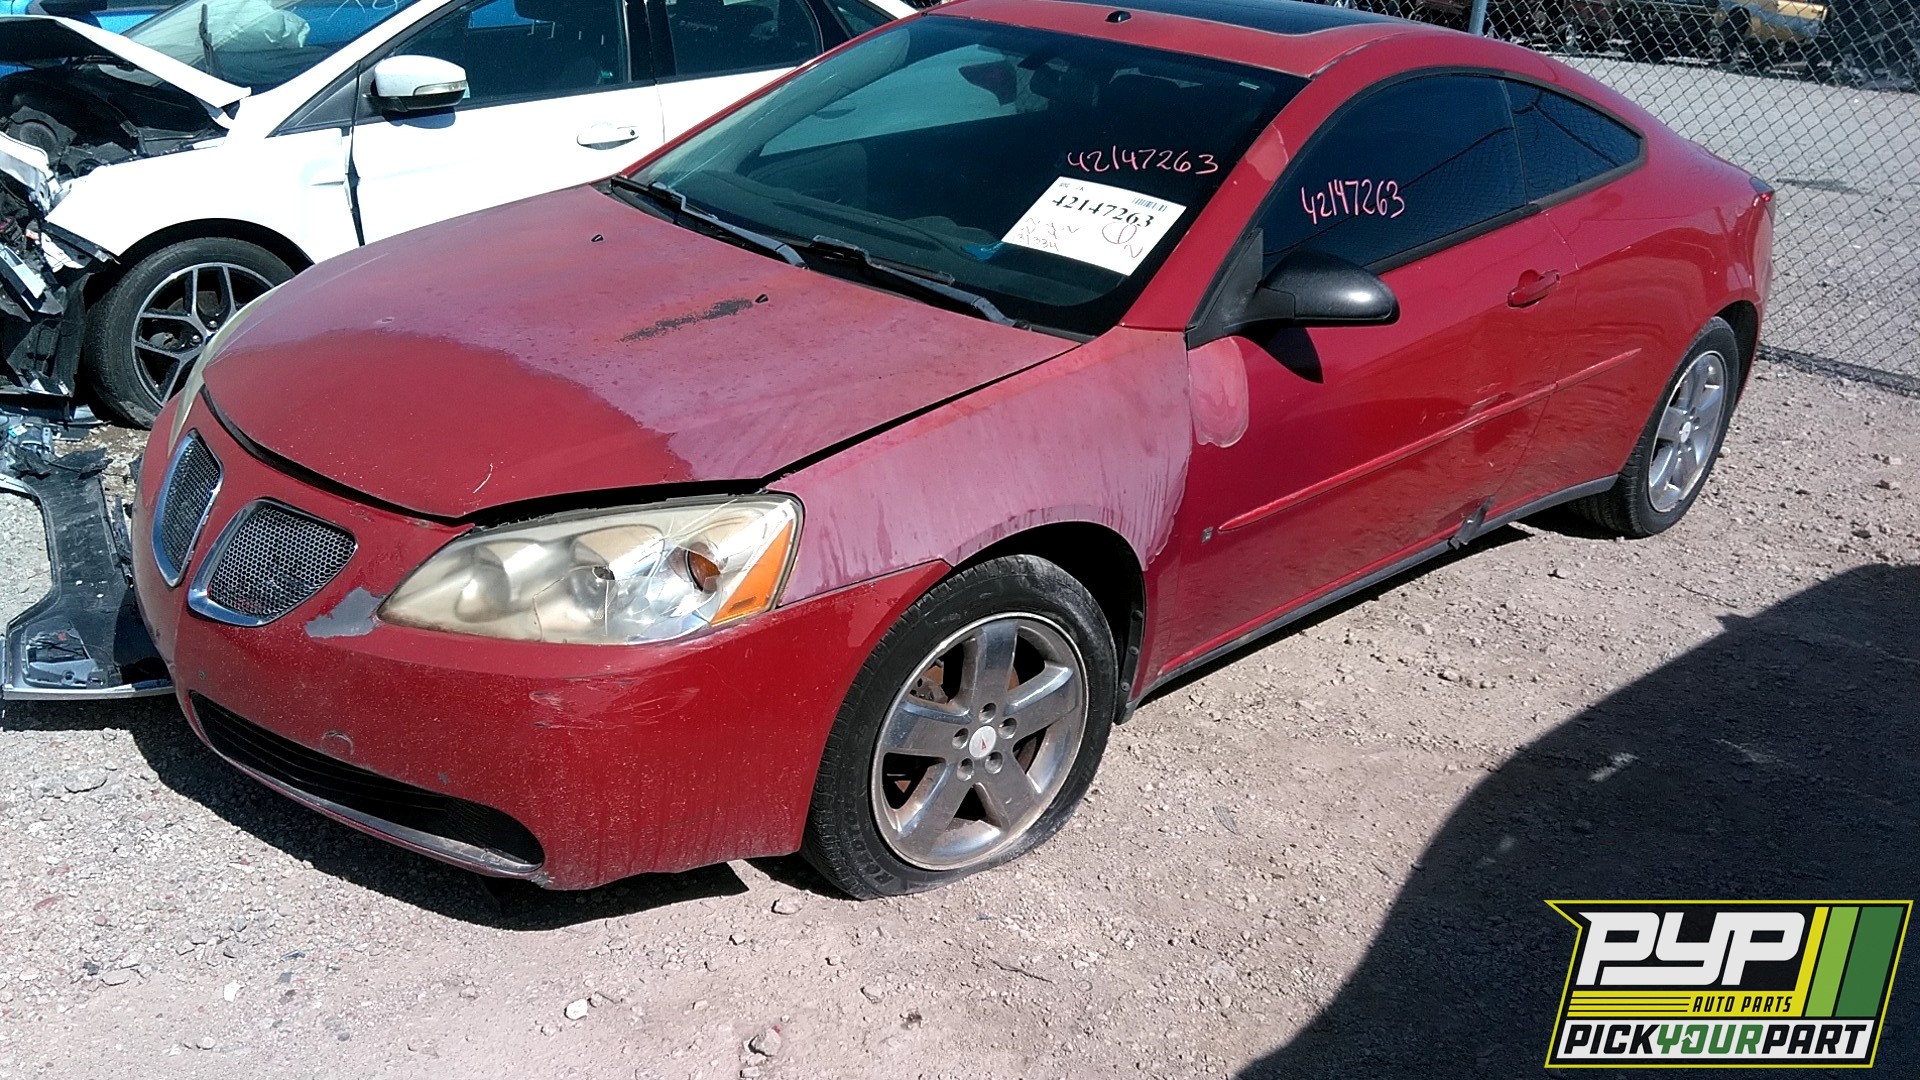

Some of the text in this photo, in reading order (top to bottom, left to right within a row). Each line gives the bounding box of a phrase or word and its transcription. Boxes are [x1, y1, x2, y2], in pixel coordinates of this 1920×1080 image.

[1067, 145, 1219, 175] 42147263
[1052, 195, 1154, 227] 42147263
[1301, 179, 1405, 225] 42147263
